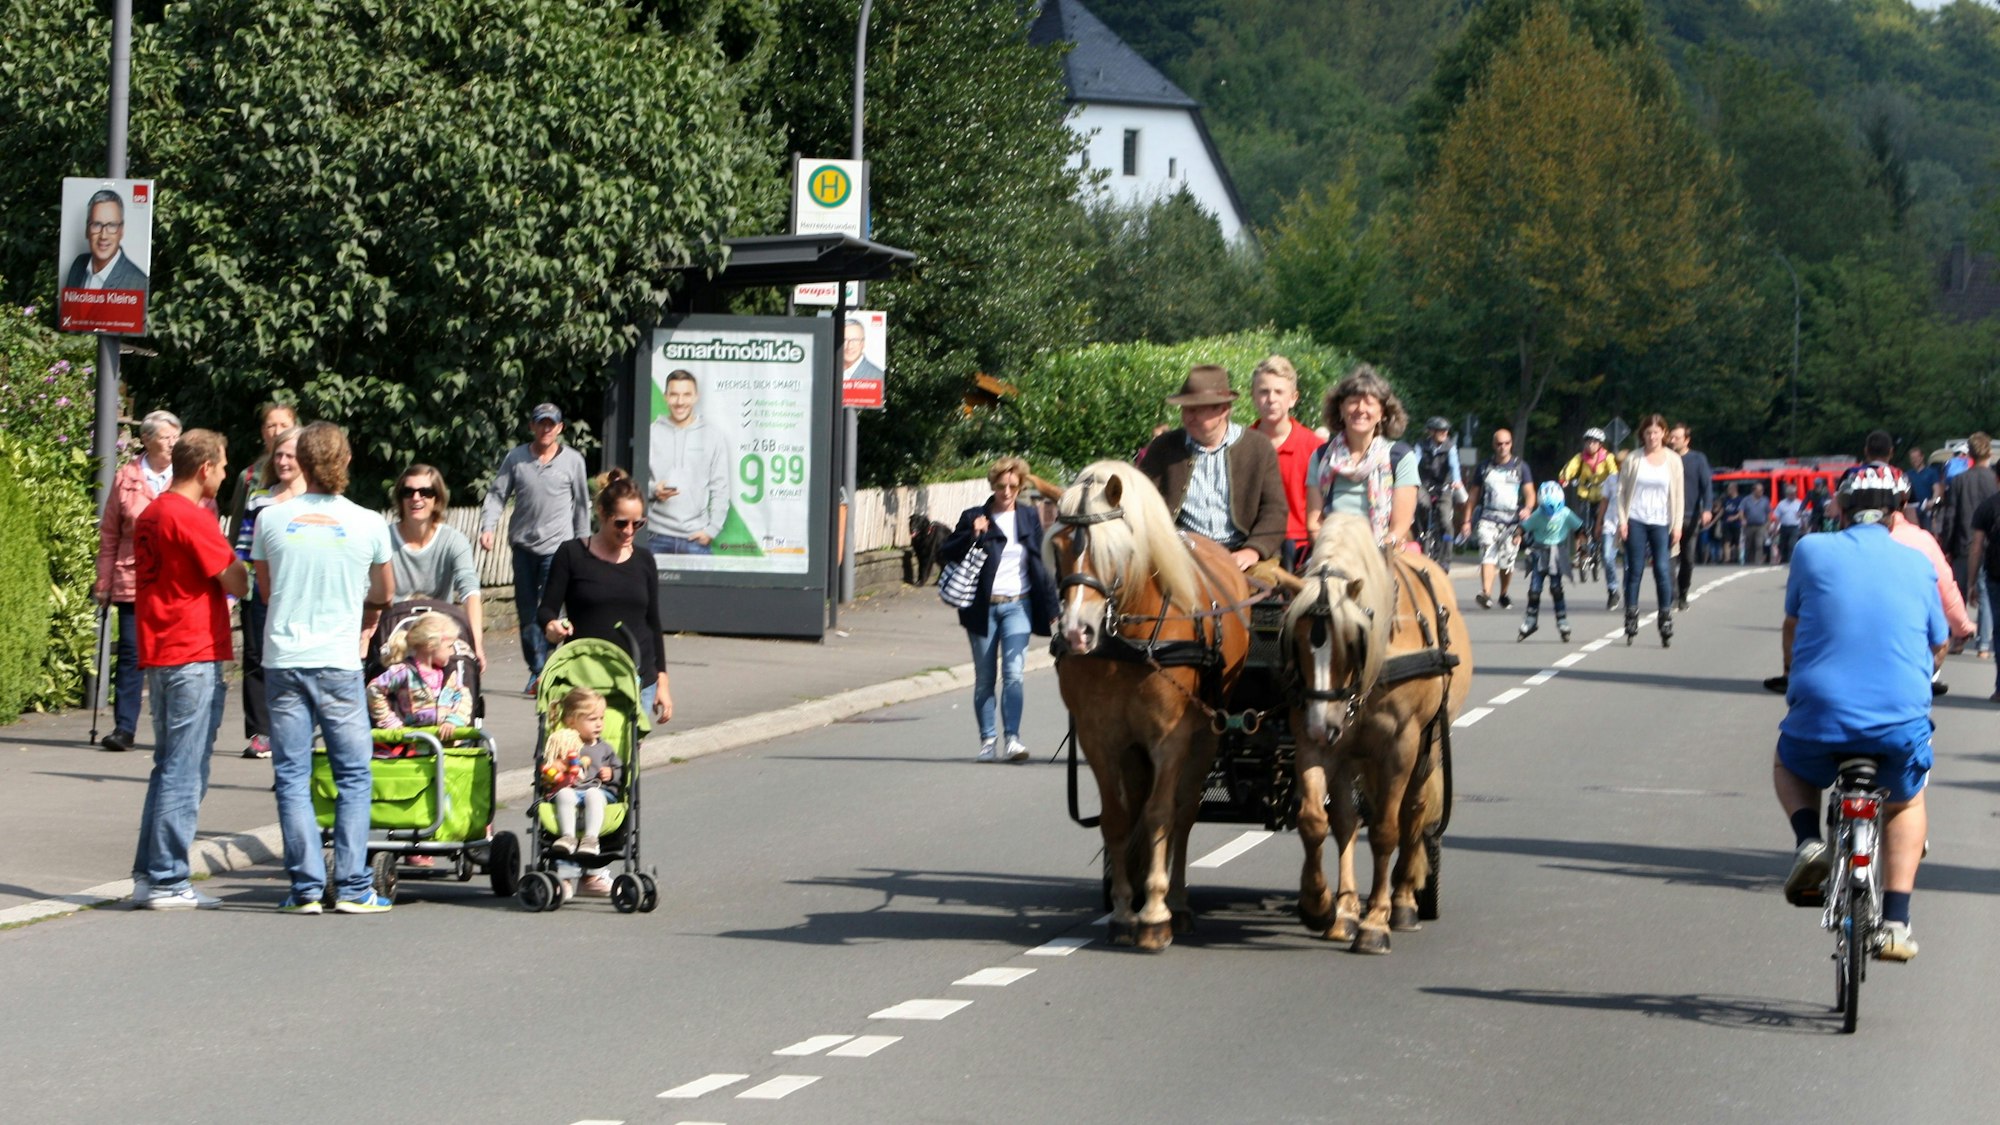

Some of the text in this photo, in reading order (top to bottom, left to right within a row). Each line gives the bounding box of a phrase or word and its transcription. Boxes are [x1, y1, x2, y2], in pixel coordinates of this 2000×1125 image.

[821, 173, 840, 199] H
[799, 284, 837, 297] wupsi
[64, 291, 138, 305] Nikolaus Kleine
[665, 340, 803, 362] smartmobil.de
[717, 379, 751, 391] WECHSEL
